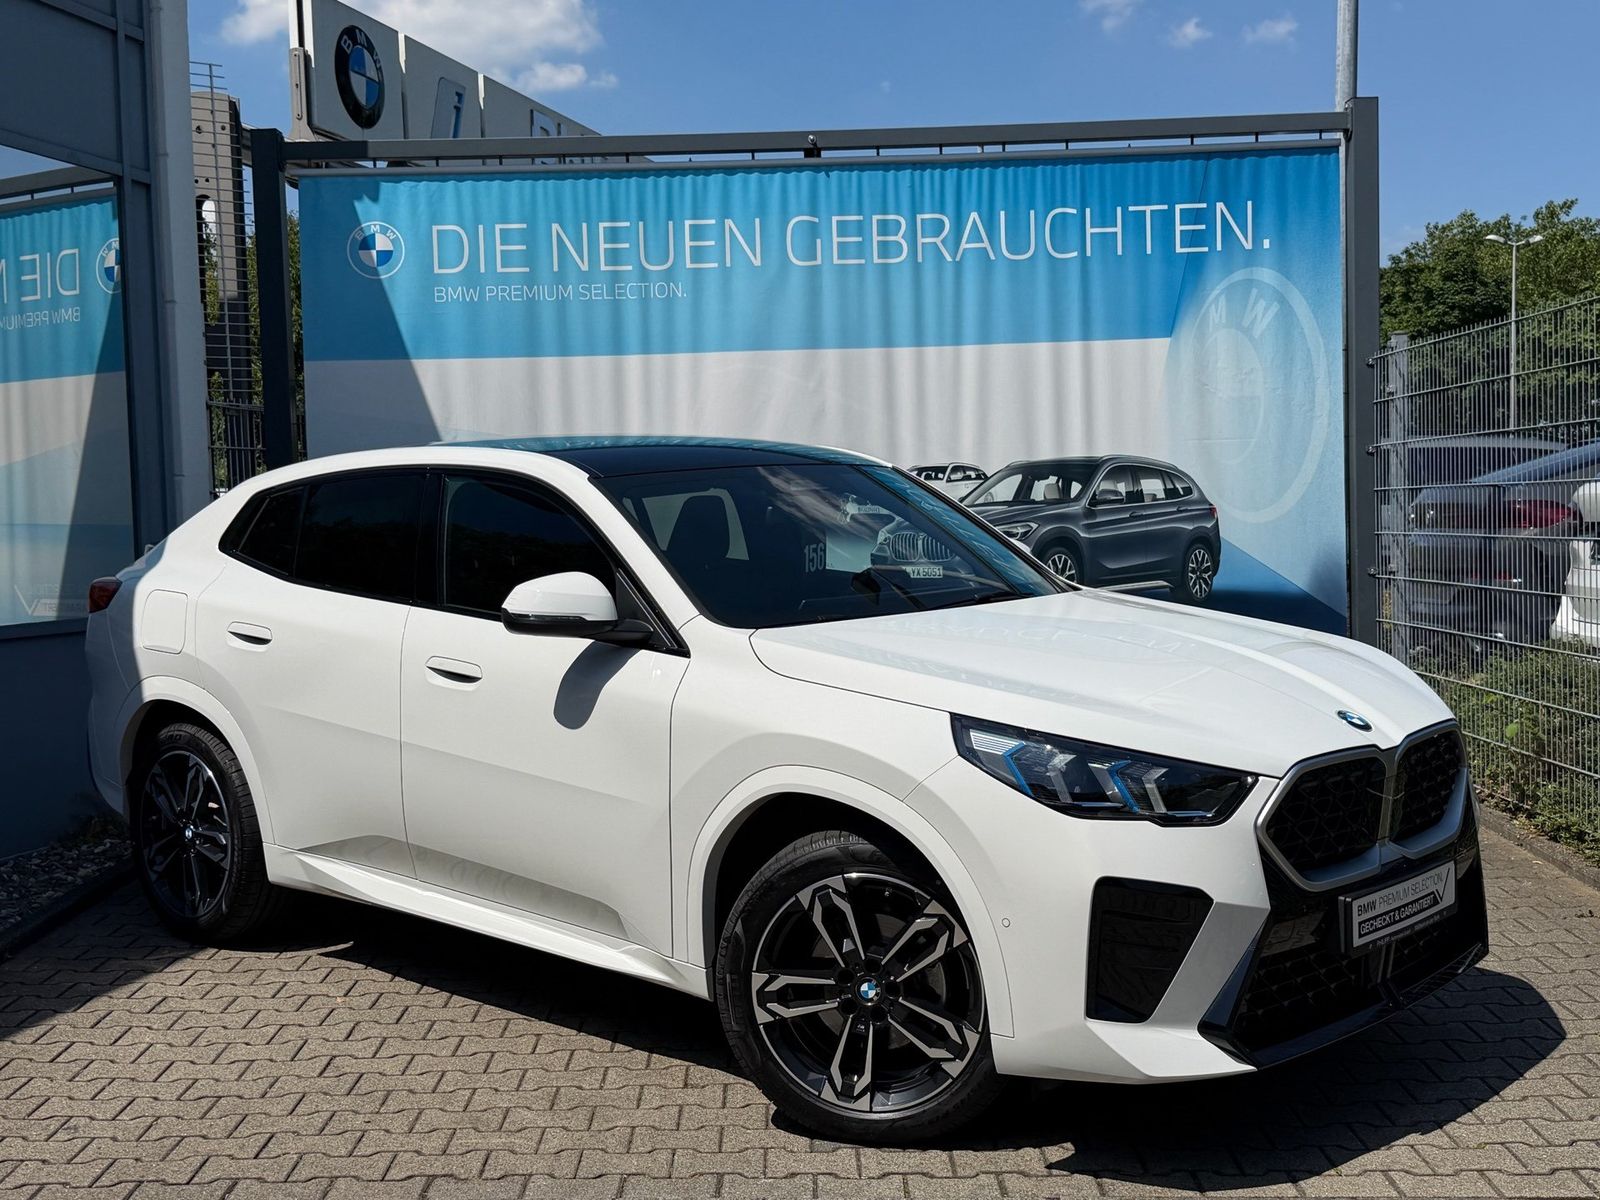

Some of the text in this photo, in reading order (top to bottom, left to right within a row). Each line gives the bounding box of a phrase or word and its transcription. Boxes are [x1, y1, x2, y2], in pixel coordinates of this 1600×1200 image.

[341, 29, 382, 69] BMW
[355, 224, 396, 240] BMW
[432, 200, 1271, 274] DIE NEUEN GEBRAUCHTEN.
[434, 282, 687, 303] BMW PREMIUM SELECTION.
[804, 543, 825, 573] 156
[1357, 899, 1377, 917] BMW
[1378, 886, 1410, 908] PREMIUM
[1360, 912, 1394, 935] GECHECKT
[1394, 909, 1400, 921] &
[1400, 894, 1435, 919] GARANTIERT
